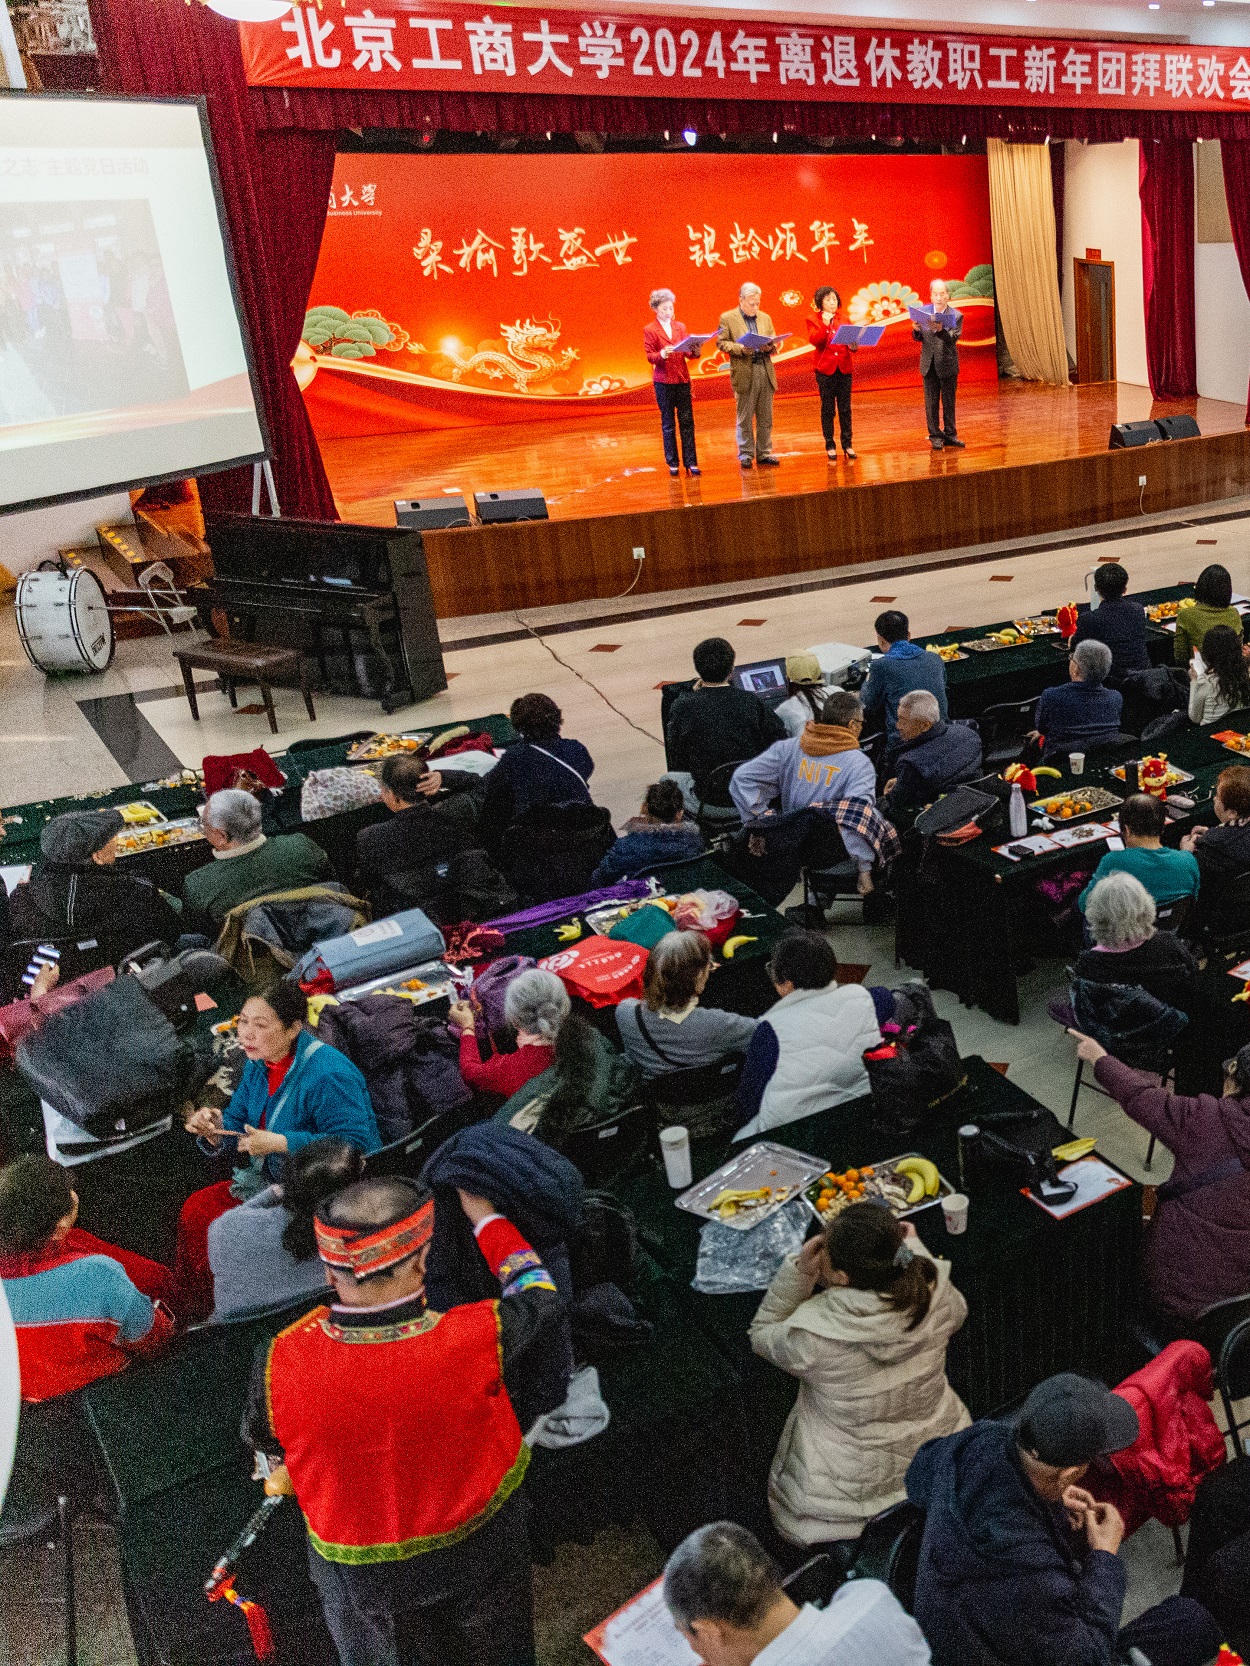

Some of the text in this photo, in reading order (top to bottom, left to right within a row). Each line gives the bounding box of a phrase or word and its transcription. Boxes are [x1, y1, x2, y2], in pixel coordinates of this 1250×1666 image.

[413, 218, 875, 280] 桑榆歌盛世 银龄颂华年
[798, 758, 841, 787] NIT
